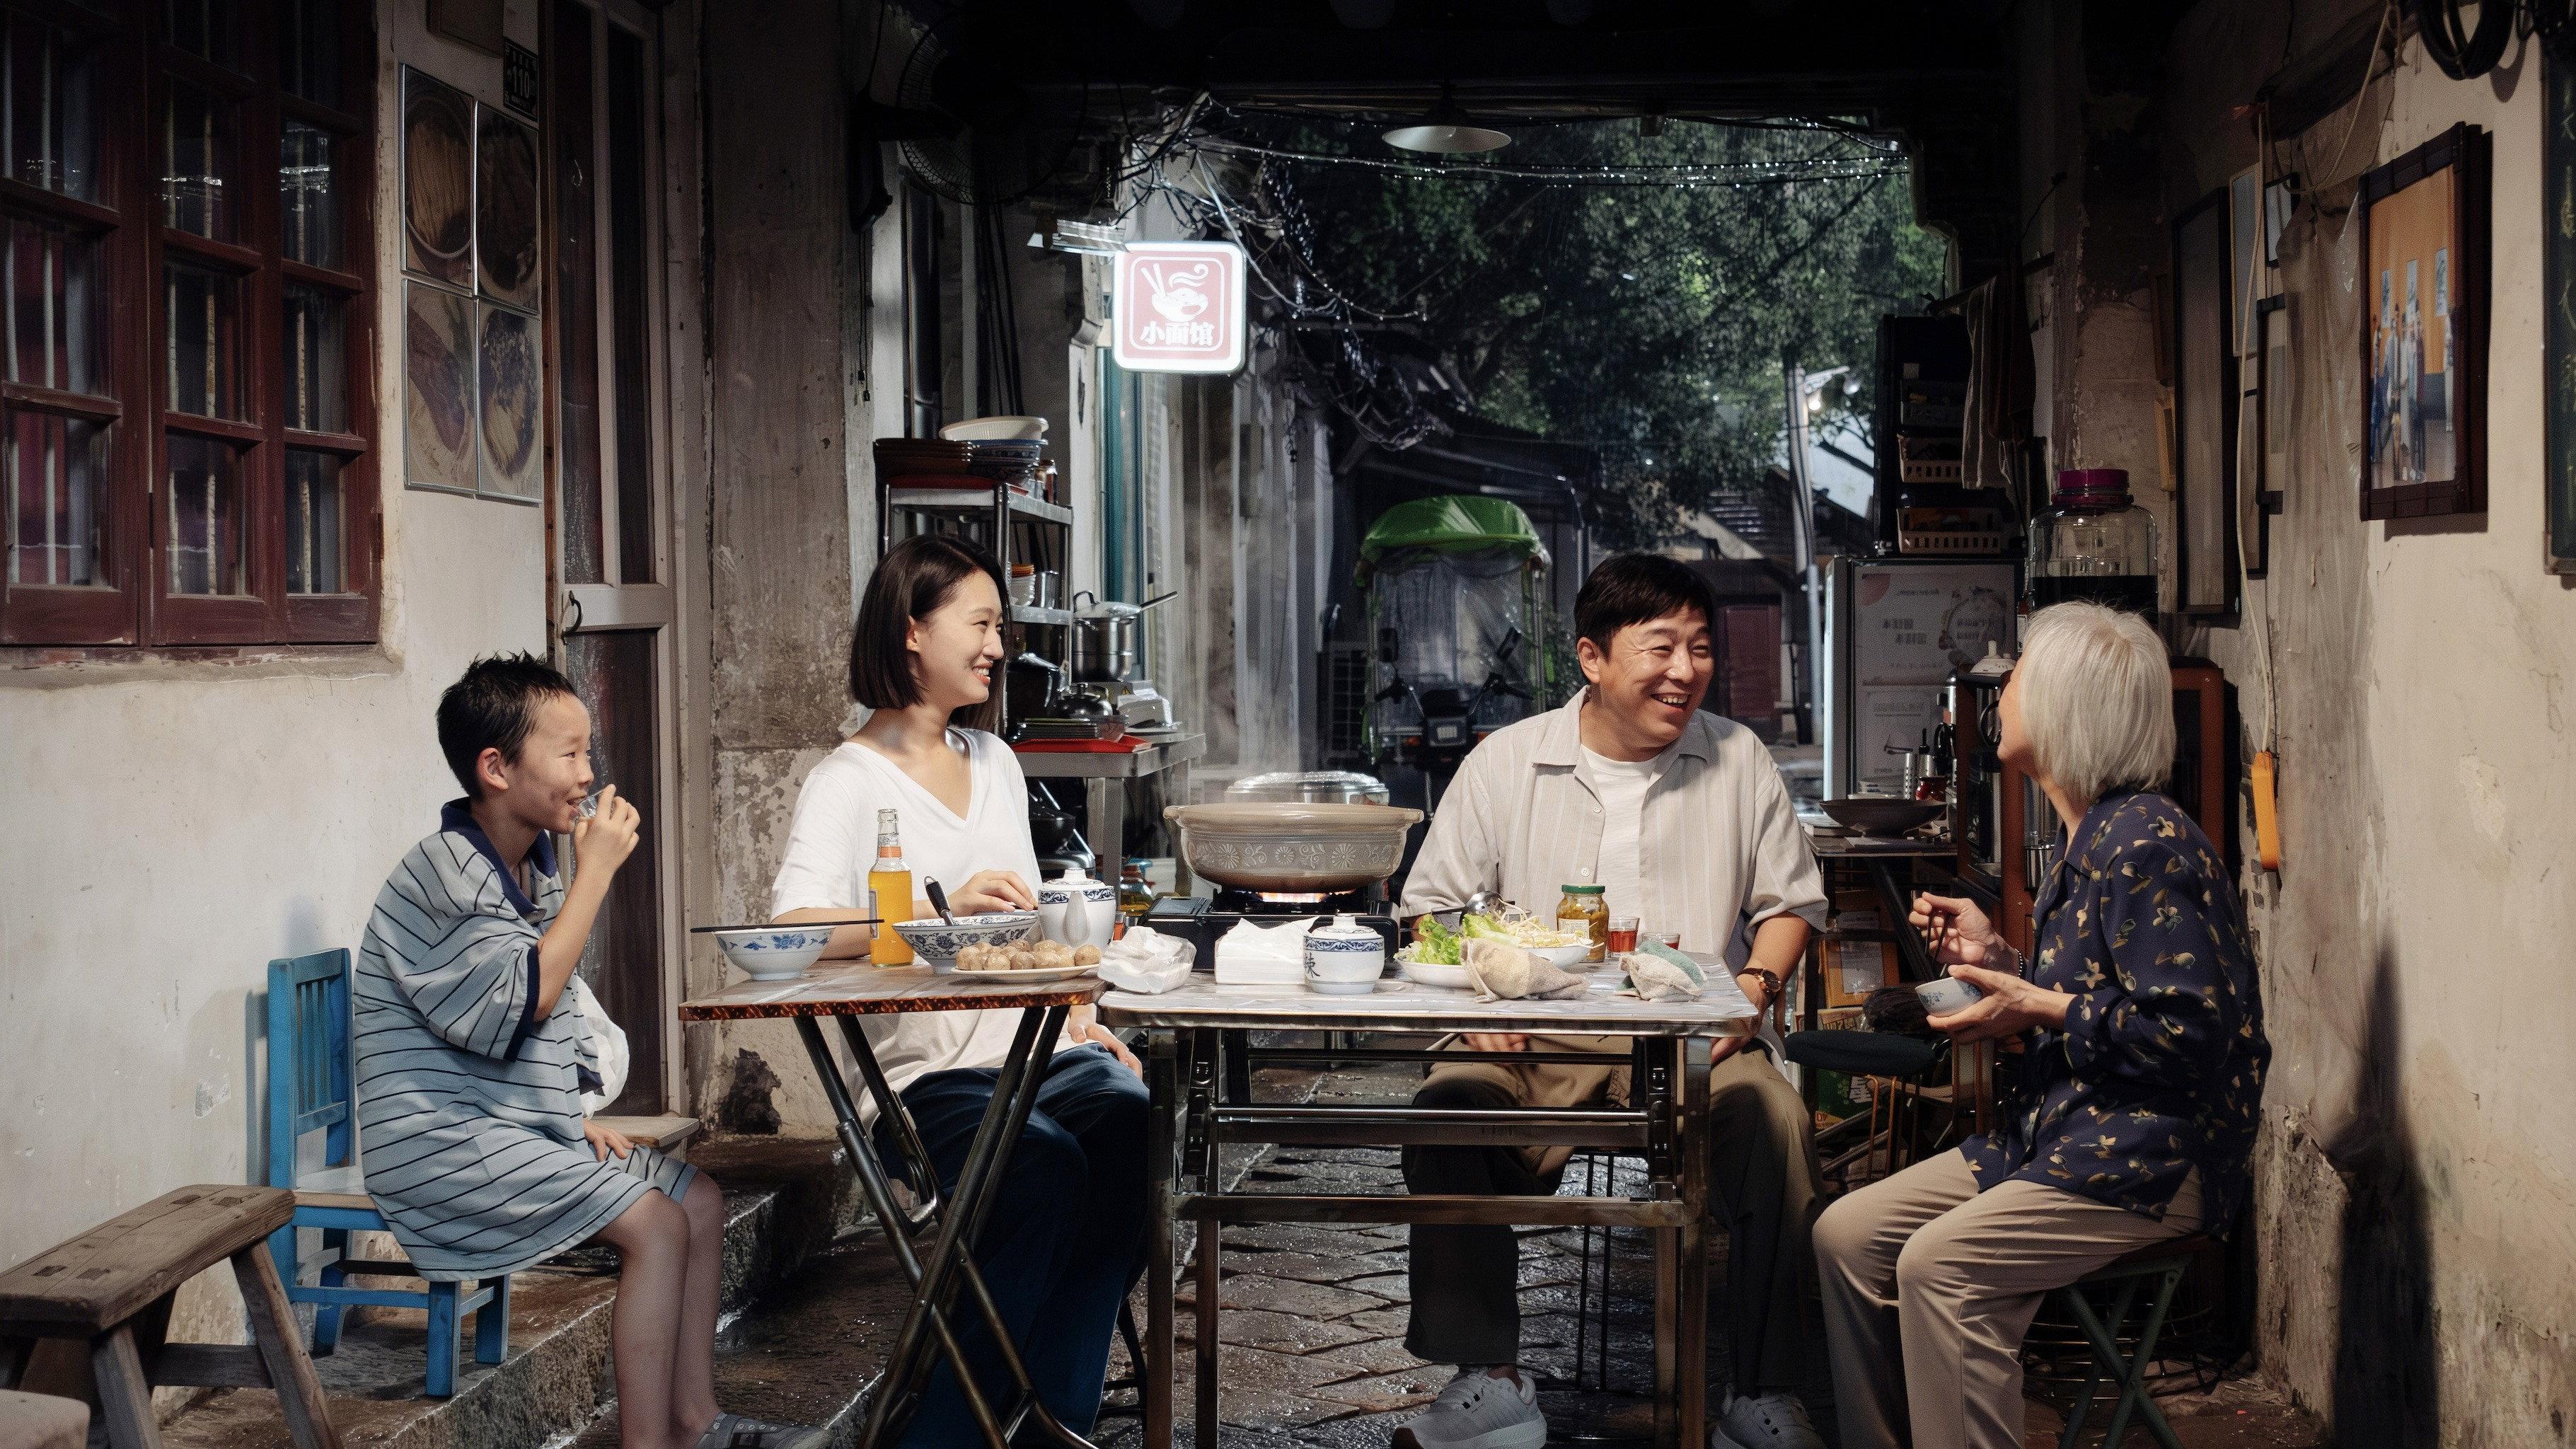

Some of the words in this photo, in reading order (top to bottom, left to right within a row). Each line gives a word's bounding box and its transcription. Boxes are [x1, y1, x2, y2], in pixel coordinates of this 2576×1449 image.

[513, 66, 530, 98] 110
[1139, 321, 1215, 346] 小面馆
